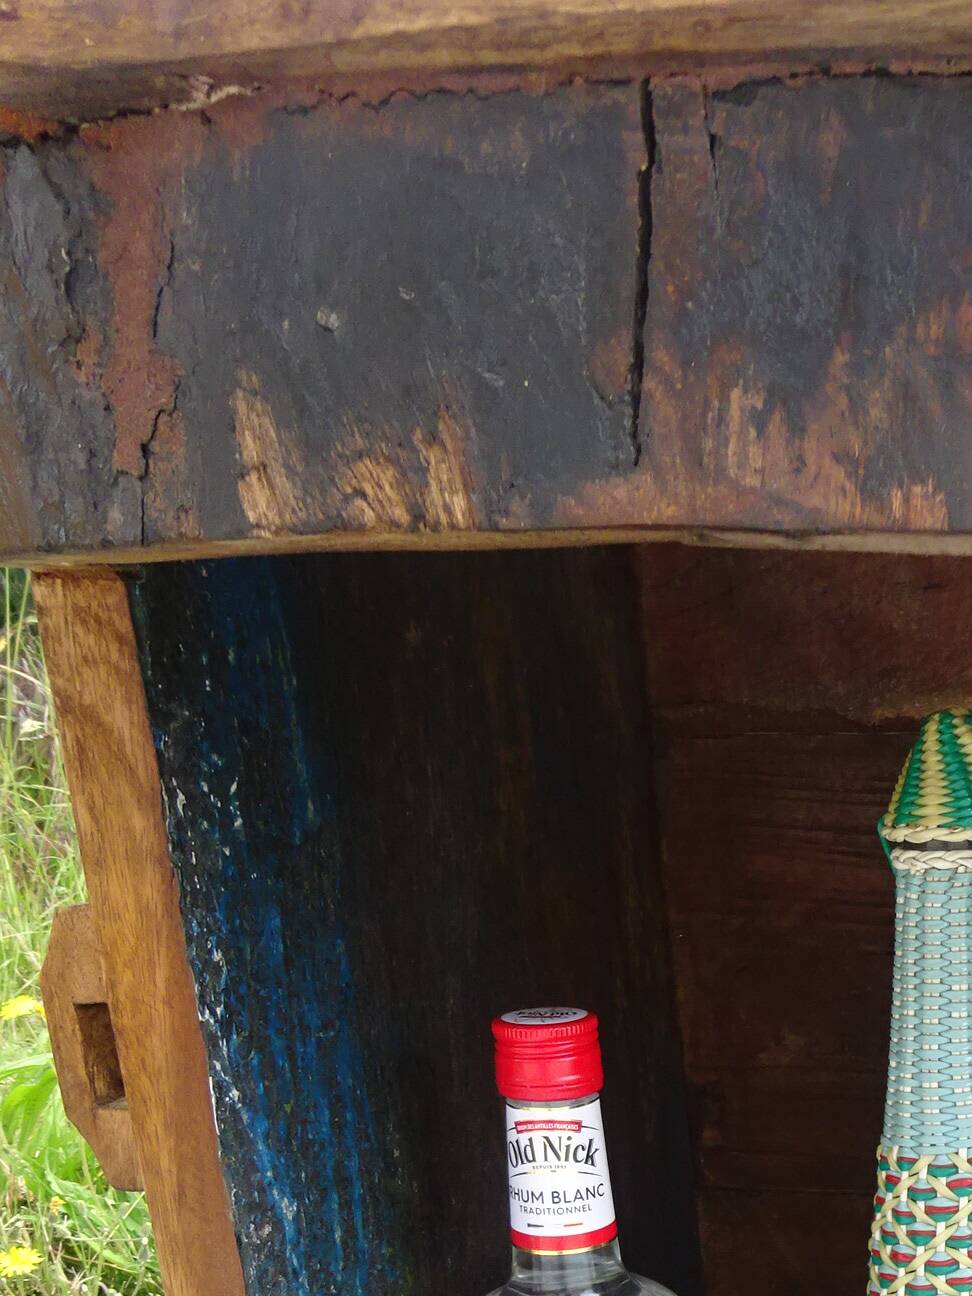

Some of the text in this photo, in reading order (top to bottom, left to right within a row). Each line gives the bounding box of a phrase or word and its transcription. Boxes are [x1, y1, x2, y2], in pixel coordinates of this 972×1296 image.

[508, 1136, 599, 1168] Old Nick
[509, 1183, 605, 1204] RHUM BLANC
[520, 1203, 592, 1215] TRADITIONNEL
